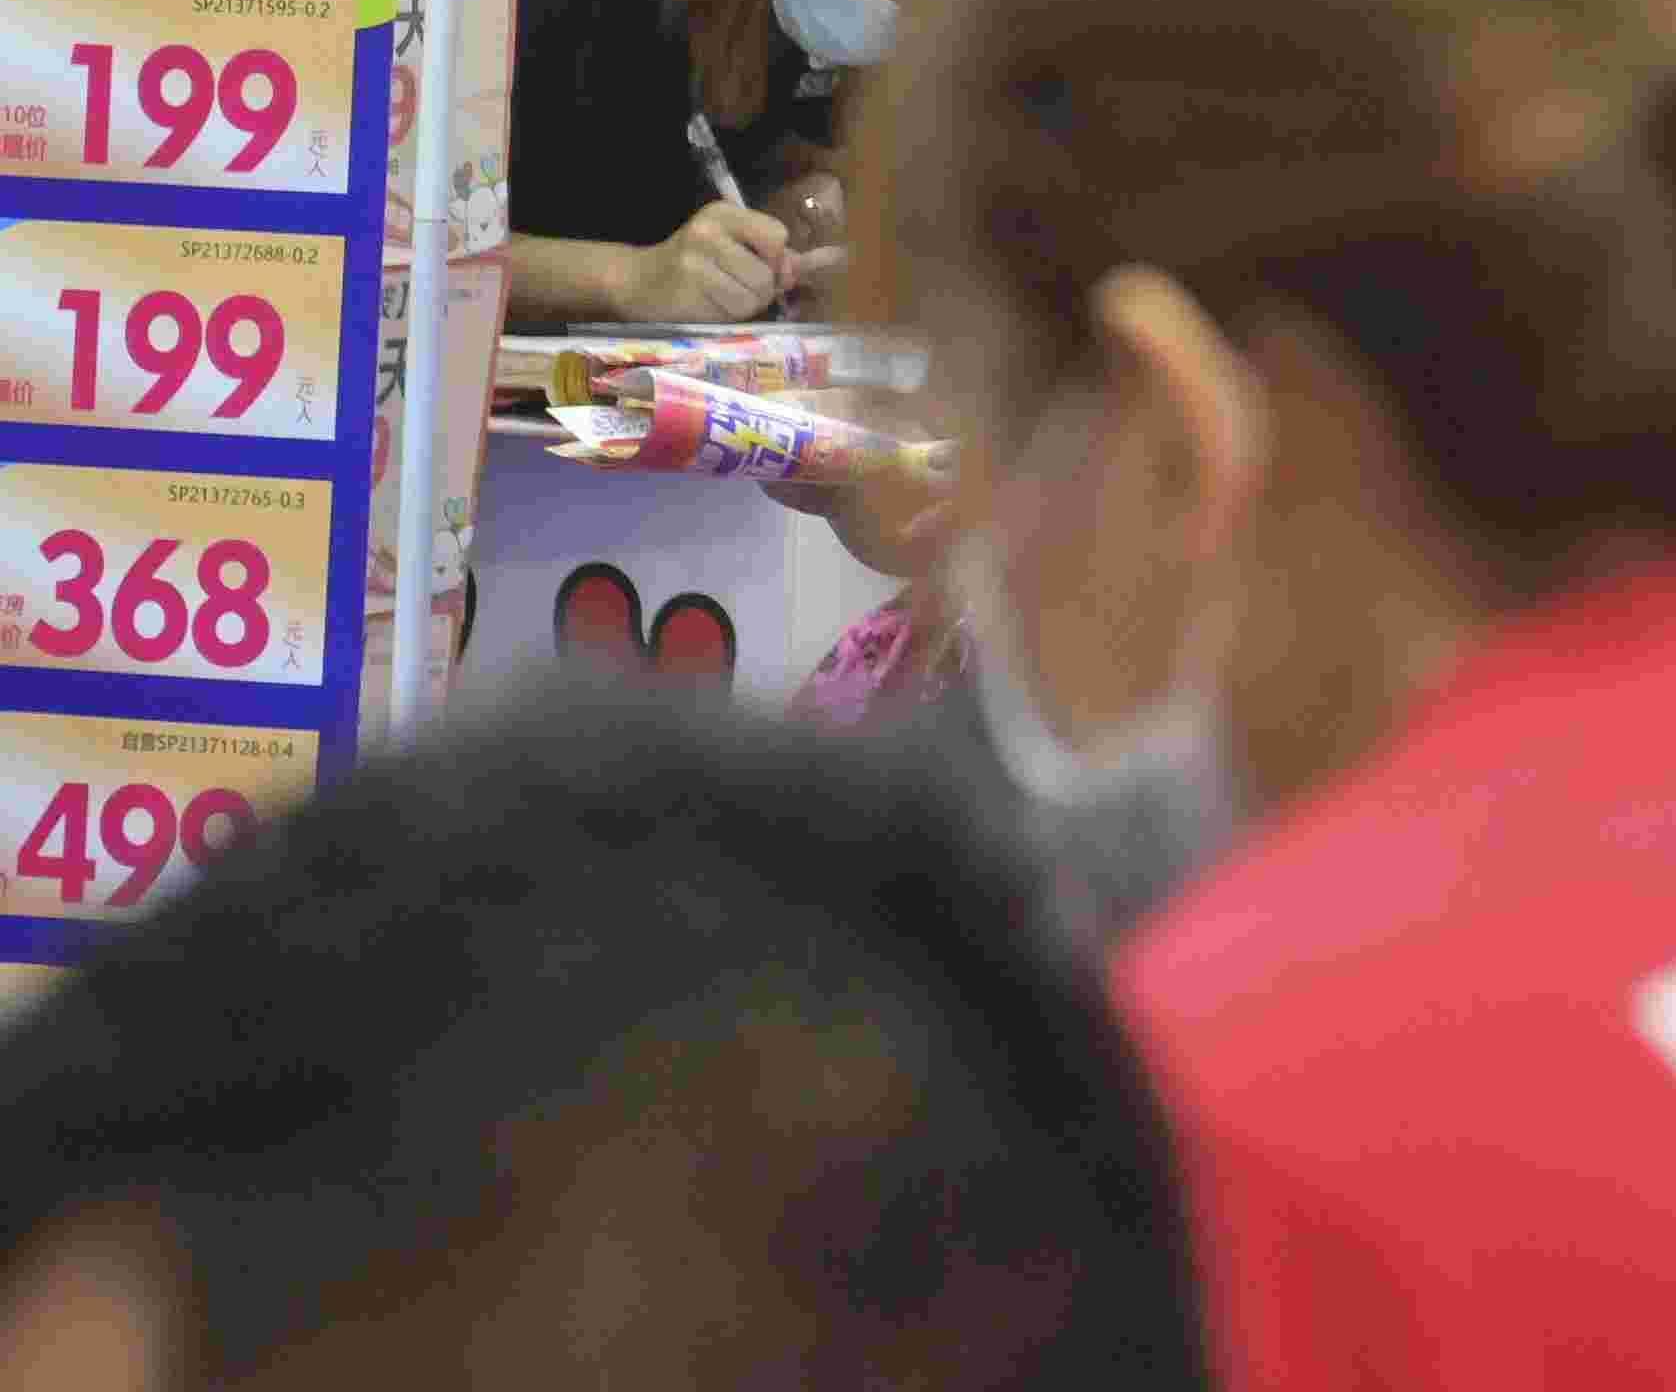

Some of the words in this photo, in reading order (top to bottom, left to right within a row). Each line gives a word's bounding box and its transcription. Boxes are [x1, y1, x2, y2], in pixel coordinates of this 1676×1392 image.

[71, 43, 298, 173] 199
[57, 288, 286, 419] 199
[28, 528, 271, 669] 368
